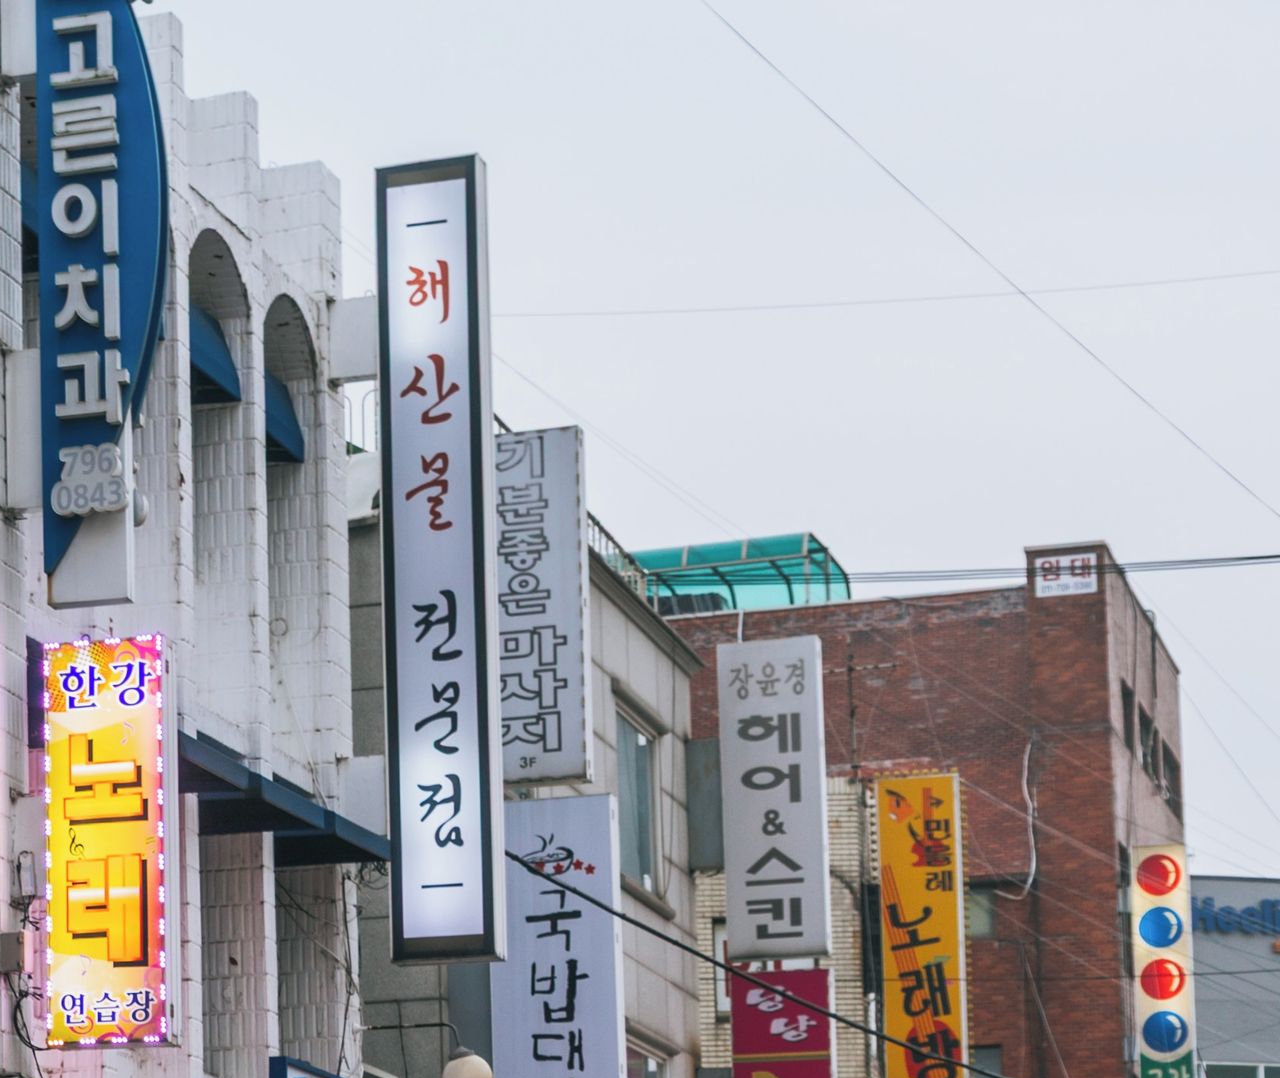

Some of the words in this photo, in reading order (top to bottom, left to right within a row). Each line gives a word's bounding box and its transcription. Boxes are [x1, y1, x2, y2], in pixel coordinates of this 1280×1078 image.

[50, 10, 131, 426] 고른이치과
[64, 447, 115, 478] 796
[56, 481, 122, 510] 0843
[59, 660, 156, 710] 한강
[500, 625, 568, 753] 마사지
[728, 658, 806, 701] 장윤경
[520, 755, 537, 769] 3F
[63, 733, 149, 968] 노래
[60, 989, 156, 1026] 연습장
